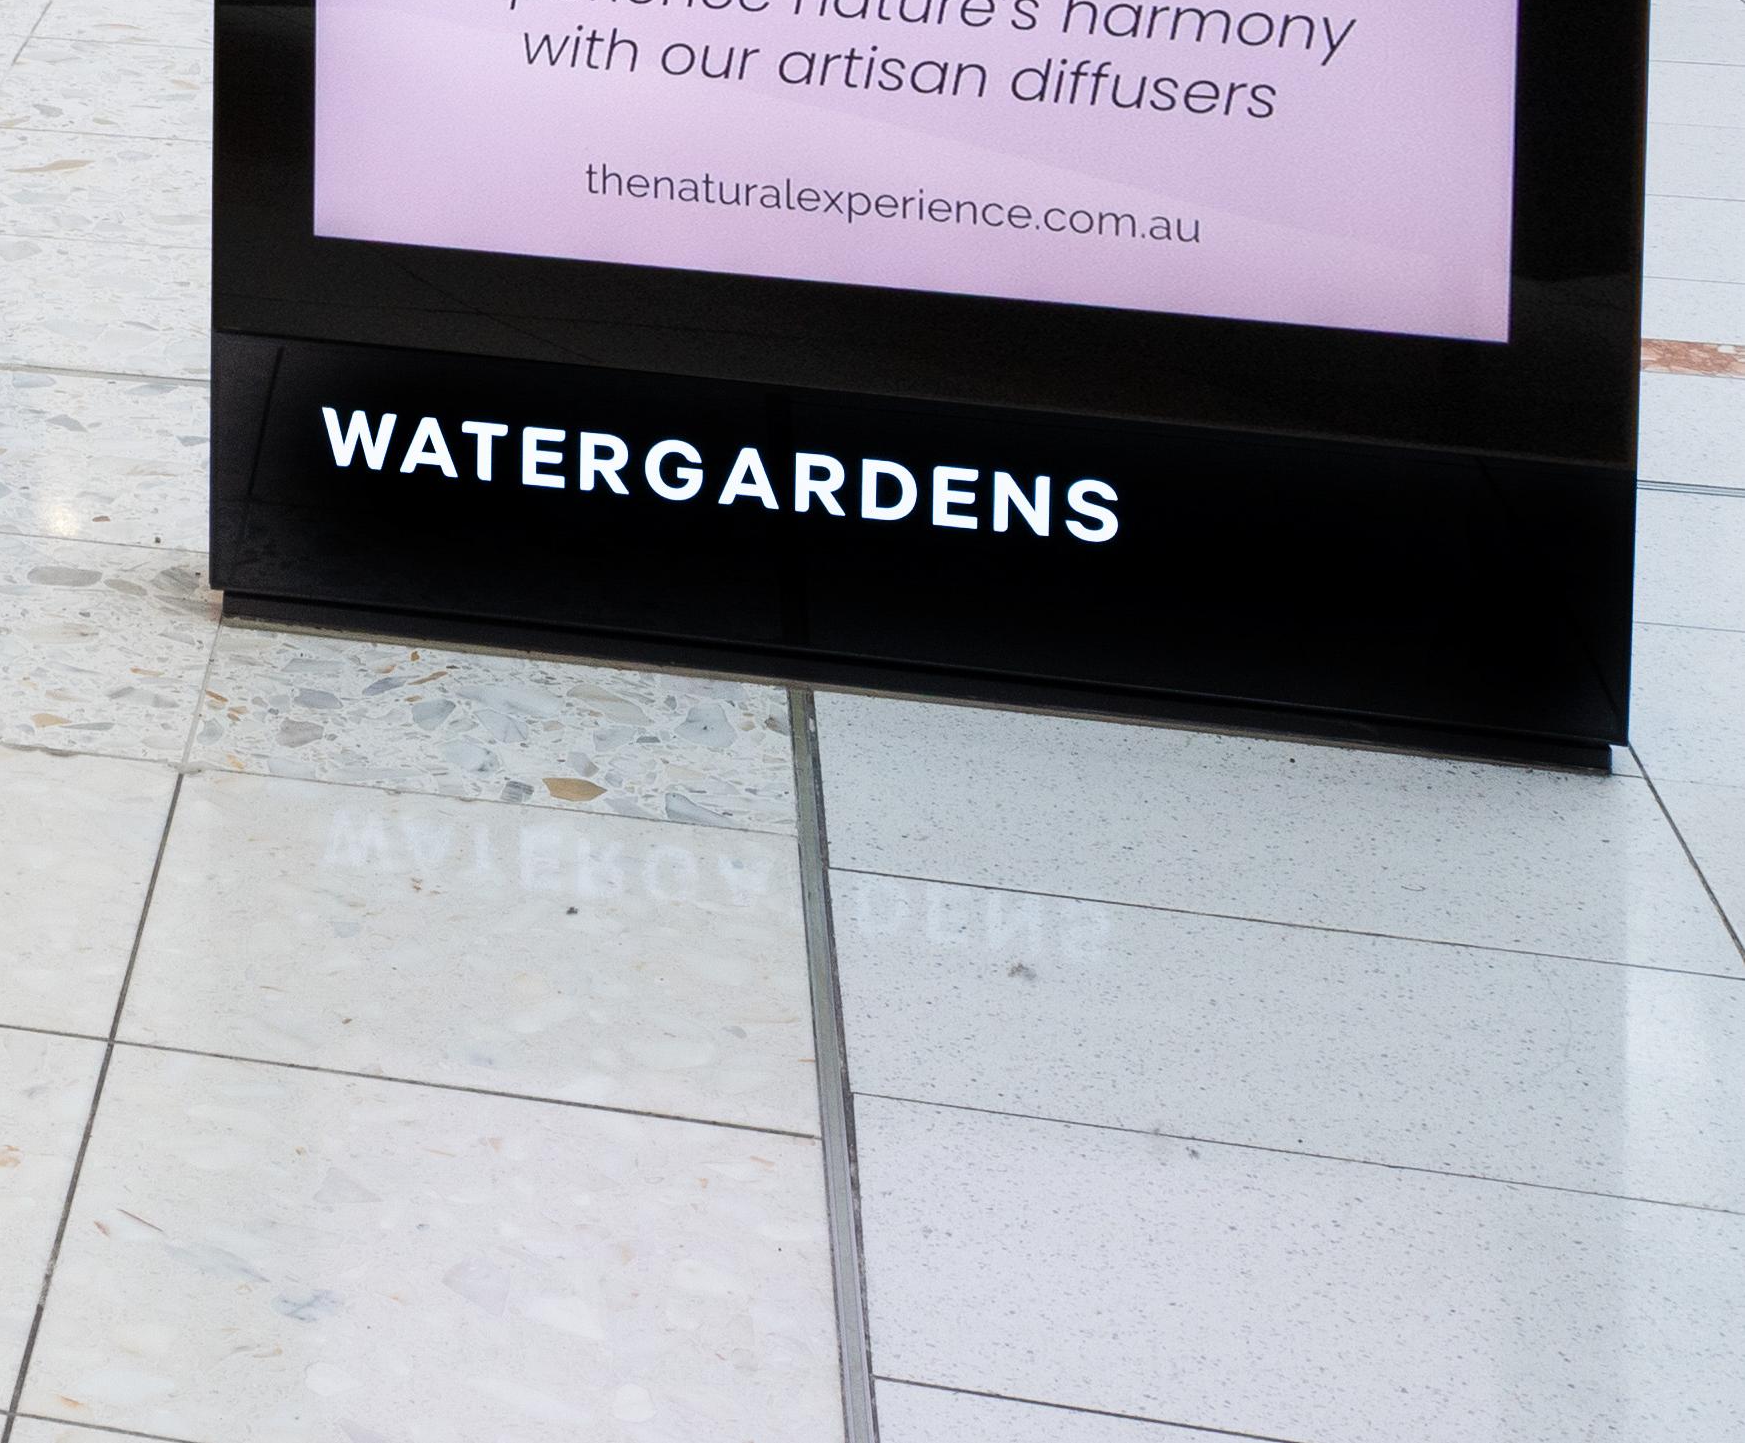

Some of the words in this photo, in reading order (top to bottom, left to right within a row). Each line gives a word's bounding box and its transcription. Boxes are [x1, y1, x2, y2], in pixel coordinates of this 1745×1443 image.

[522, 25, 639, 75] with
[660, 35, 760, 81] our
[777, 45, 989, 98] artisan
[1010, 57, 1279, 120] diffusers
[585, 163, 1201, 244] thenaturalexperience.com.au
[321, 407, 1120, 543] WATERGARDENS
